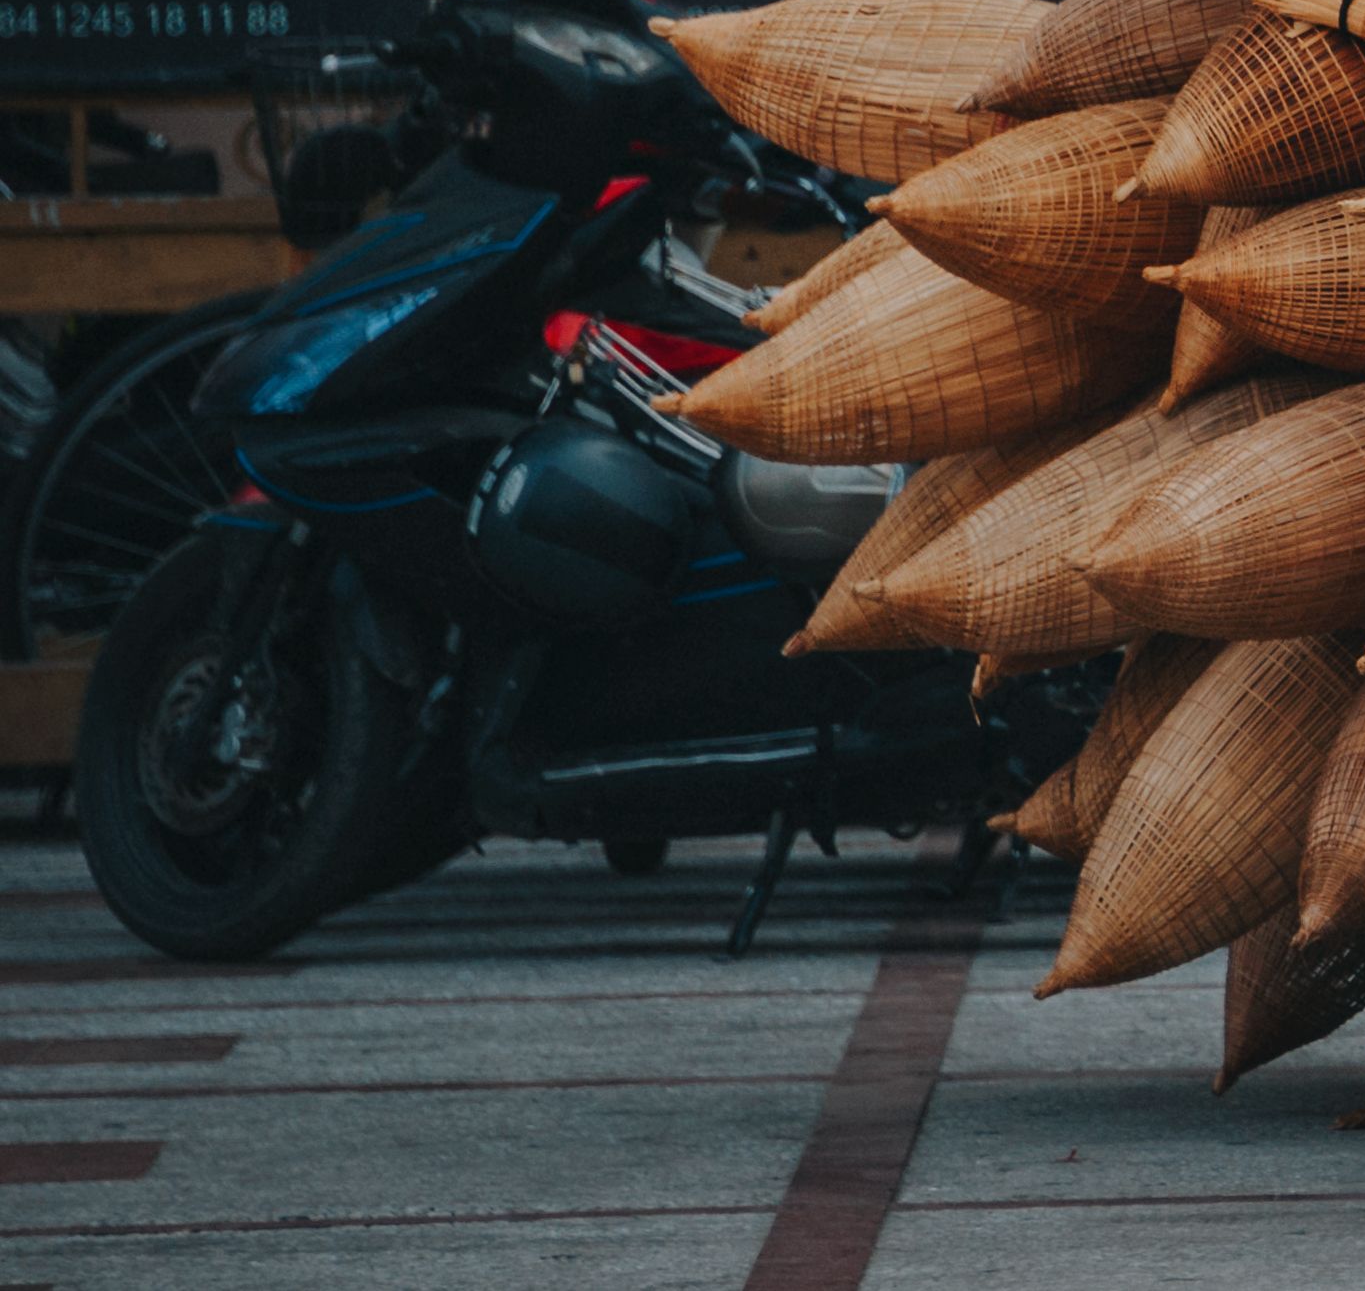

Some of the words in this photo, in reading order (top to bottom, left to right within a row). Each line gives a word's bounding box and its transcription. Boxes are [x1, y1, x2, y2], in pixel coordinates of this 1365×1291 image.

[51, 0, 135, 38] 1245
[146, 0, 187, 38] 18
[197, 0, 234, 37] 11
[246, 0, 291, 38] 88
